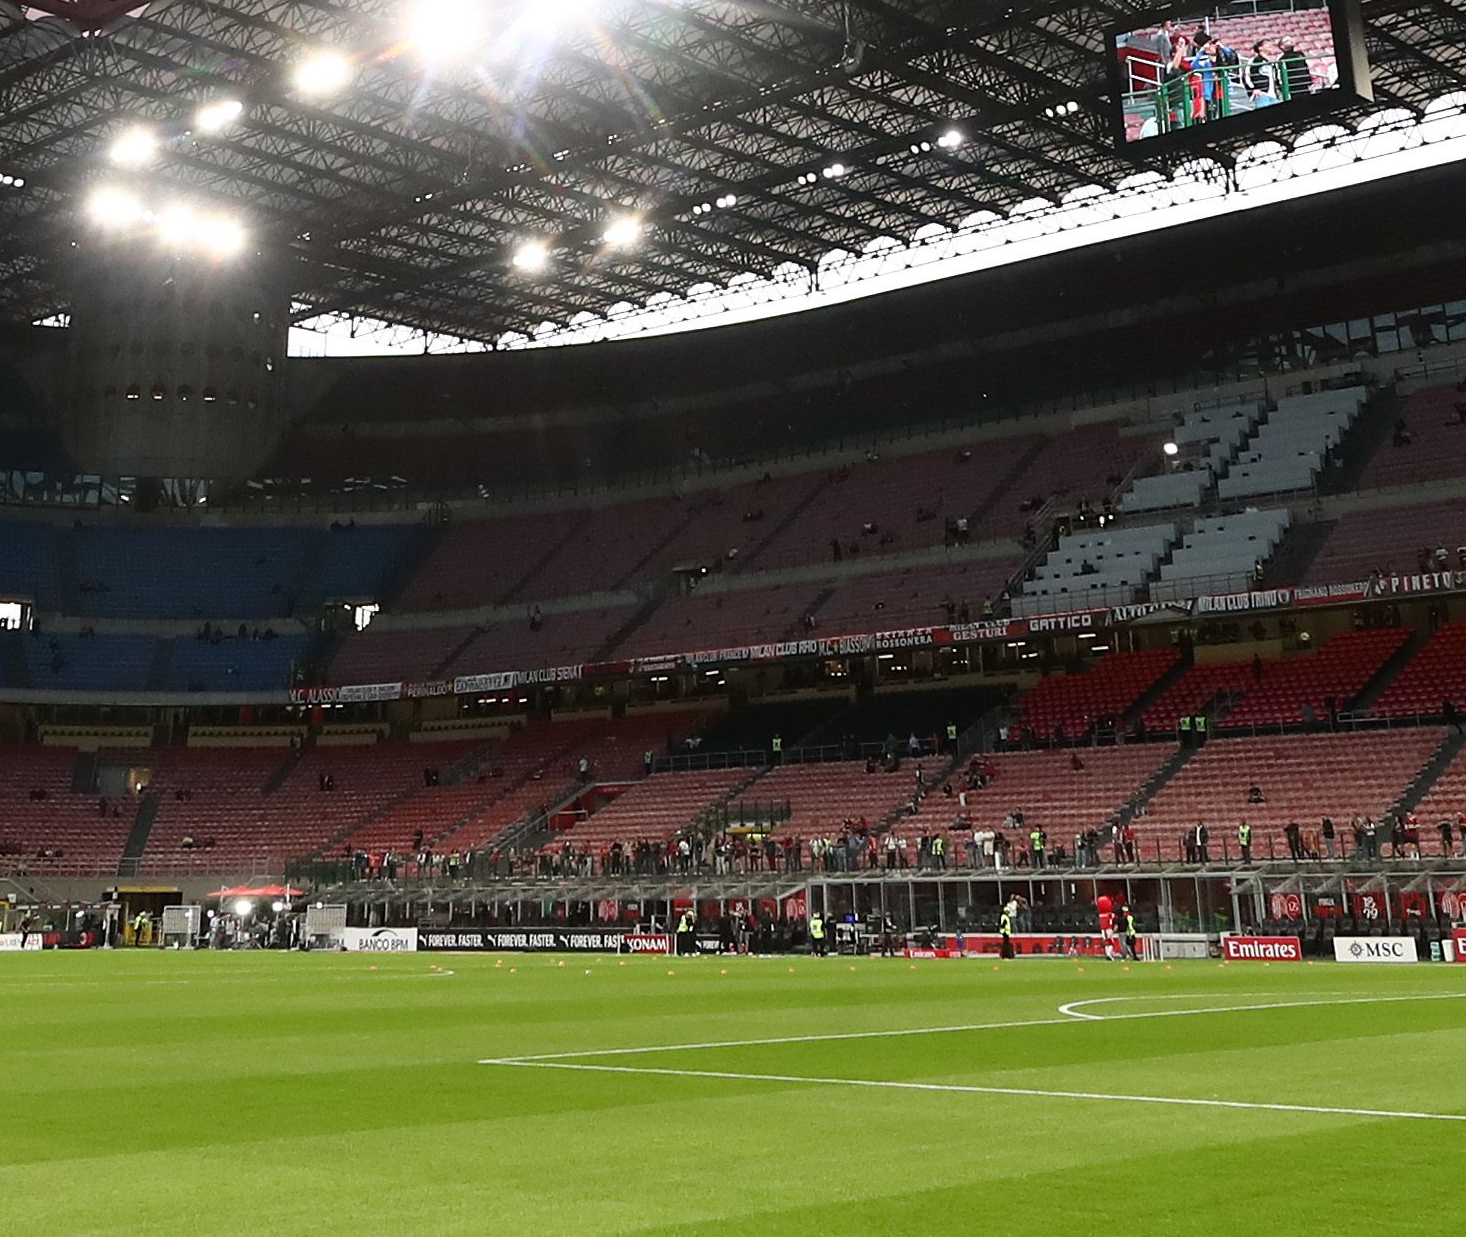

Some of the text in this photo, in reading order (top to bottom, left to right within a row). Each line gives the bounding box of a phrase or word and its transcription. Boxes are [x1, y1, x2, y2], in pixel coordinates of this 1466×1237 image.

[1391, 572, 1452, 593] PINETO
[1227, 593, 1249, 610] CLUB
[1029, 615, 1092, 632] GATTICO
[953, 626, 1007, 641] GESTURI
[750, 644, 776, 659] MILAN
[776, 641, 797, 656] CLUB
[798, 640, 817, 654] RHO
[876, 635, 933, 650] ROSSONERA
[538, 668, 555, 682] CLUB
[359, 938, 388, 951] BANCO
[390, 939, 409, 951] BPM
[1228, 940, 1297, 958] Emirates
[1366, 942, 1404, 957] MSC
